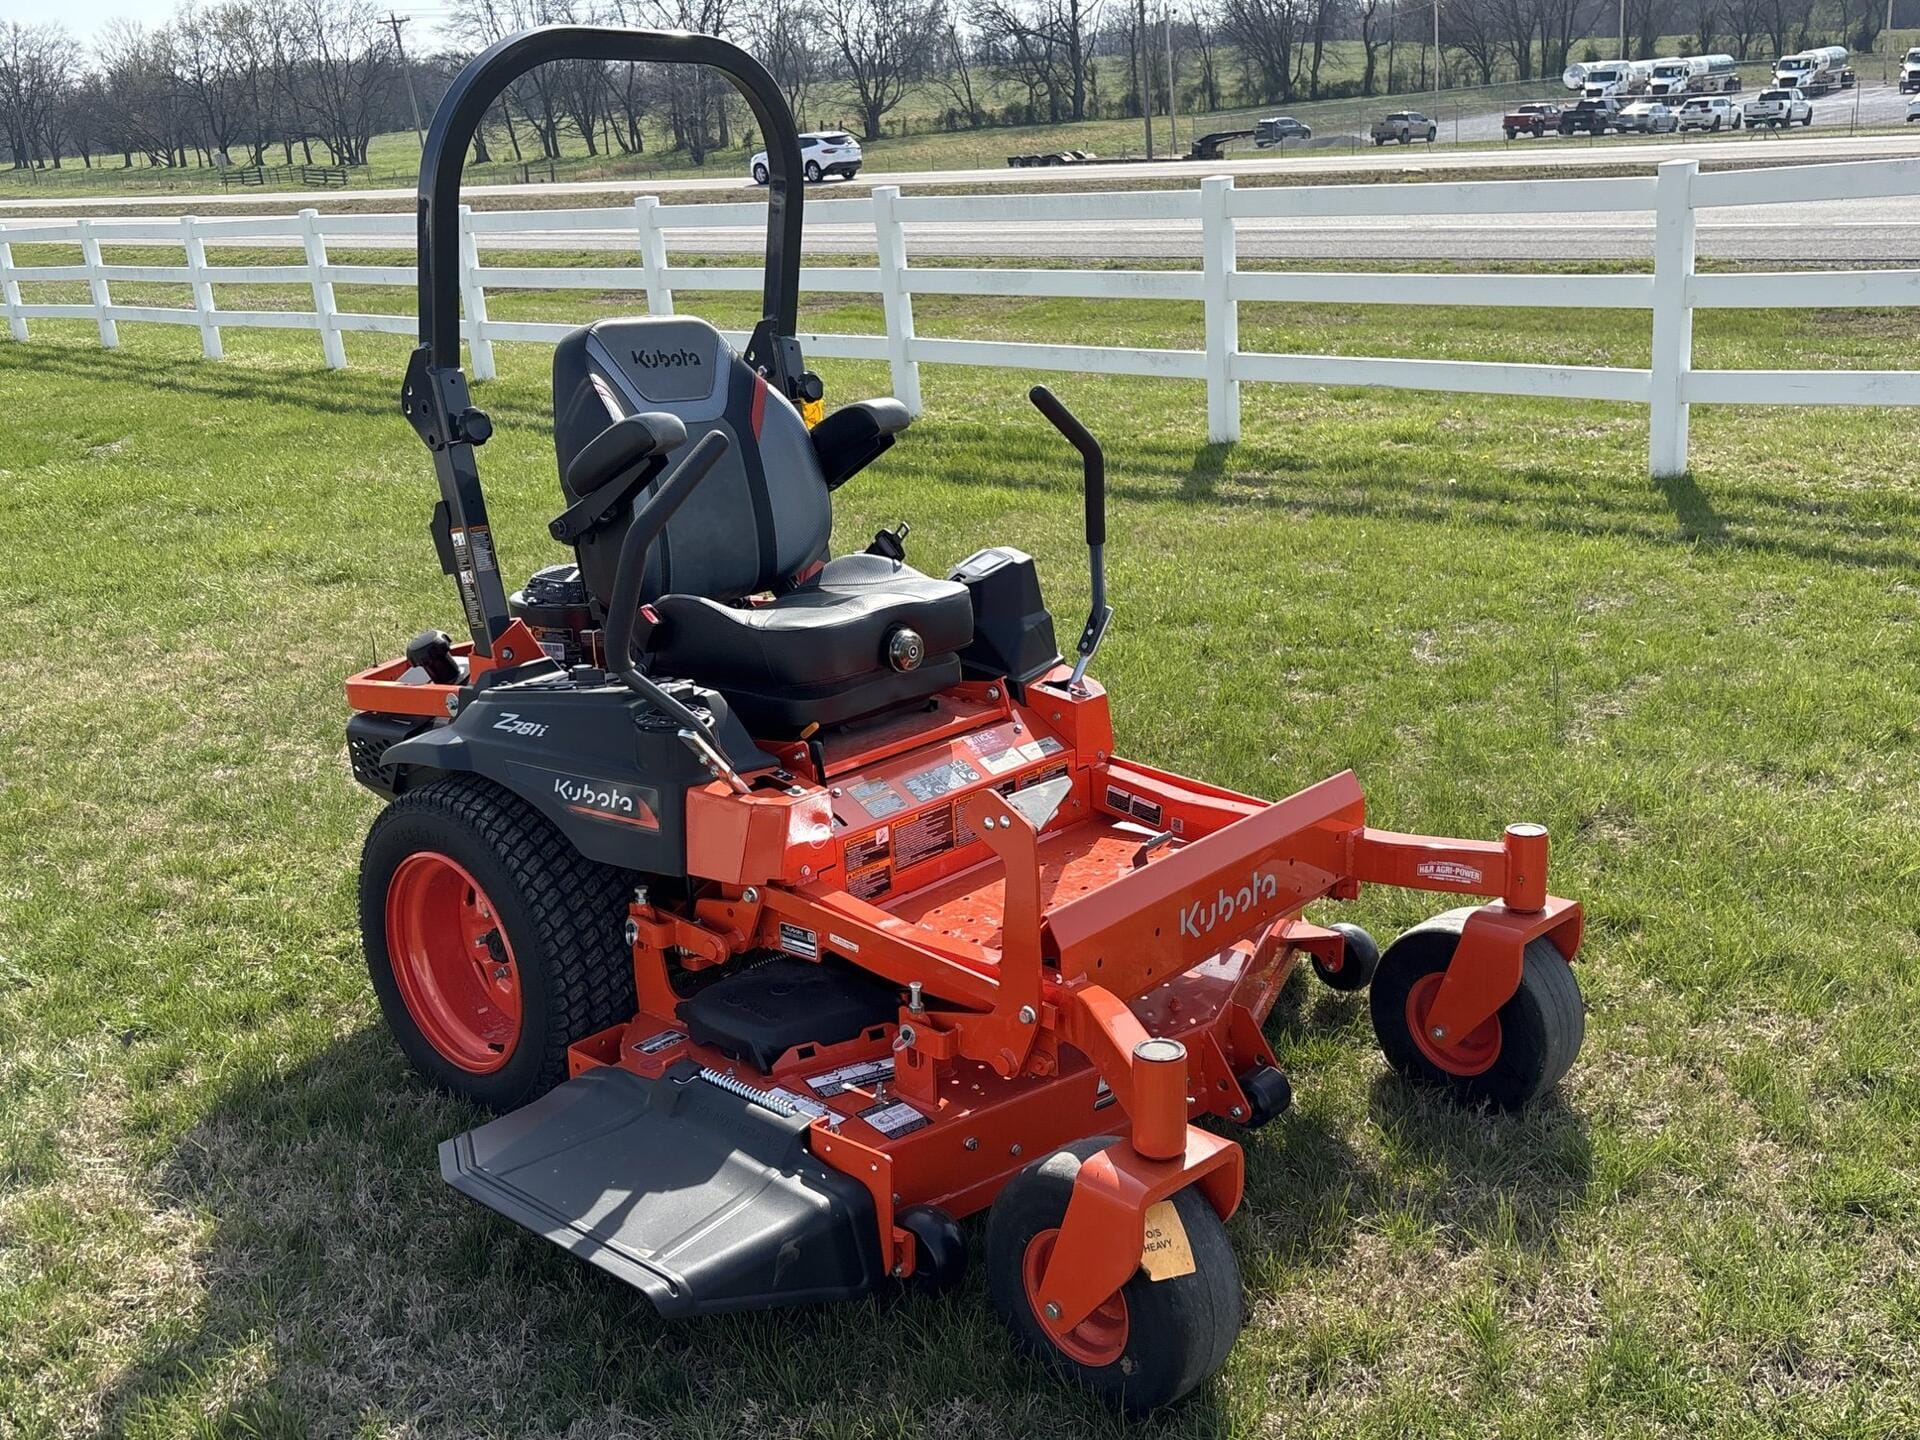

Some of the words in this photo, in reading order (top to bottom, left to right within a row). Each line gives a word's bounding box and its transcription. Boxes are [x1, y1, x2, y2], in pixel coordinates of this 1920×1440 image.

[631, 348, 702, 369] Kubota
[493, 712, 549, 737] Z781i
[554, 778, 633, 812] Kubota
[1419, 864, 1434, 874] H&R
[1435, 865, 1480, 880] AGRI-POWER
[1180, 871, 1276, 938] Kubota
[1143, 1239, 1173, 1254] HEAVY
